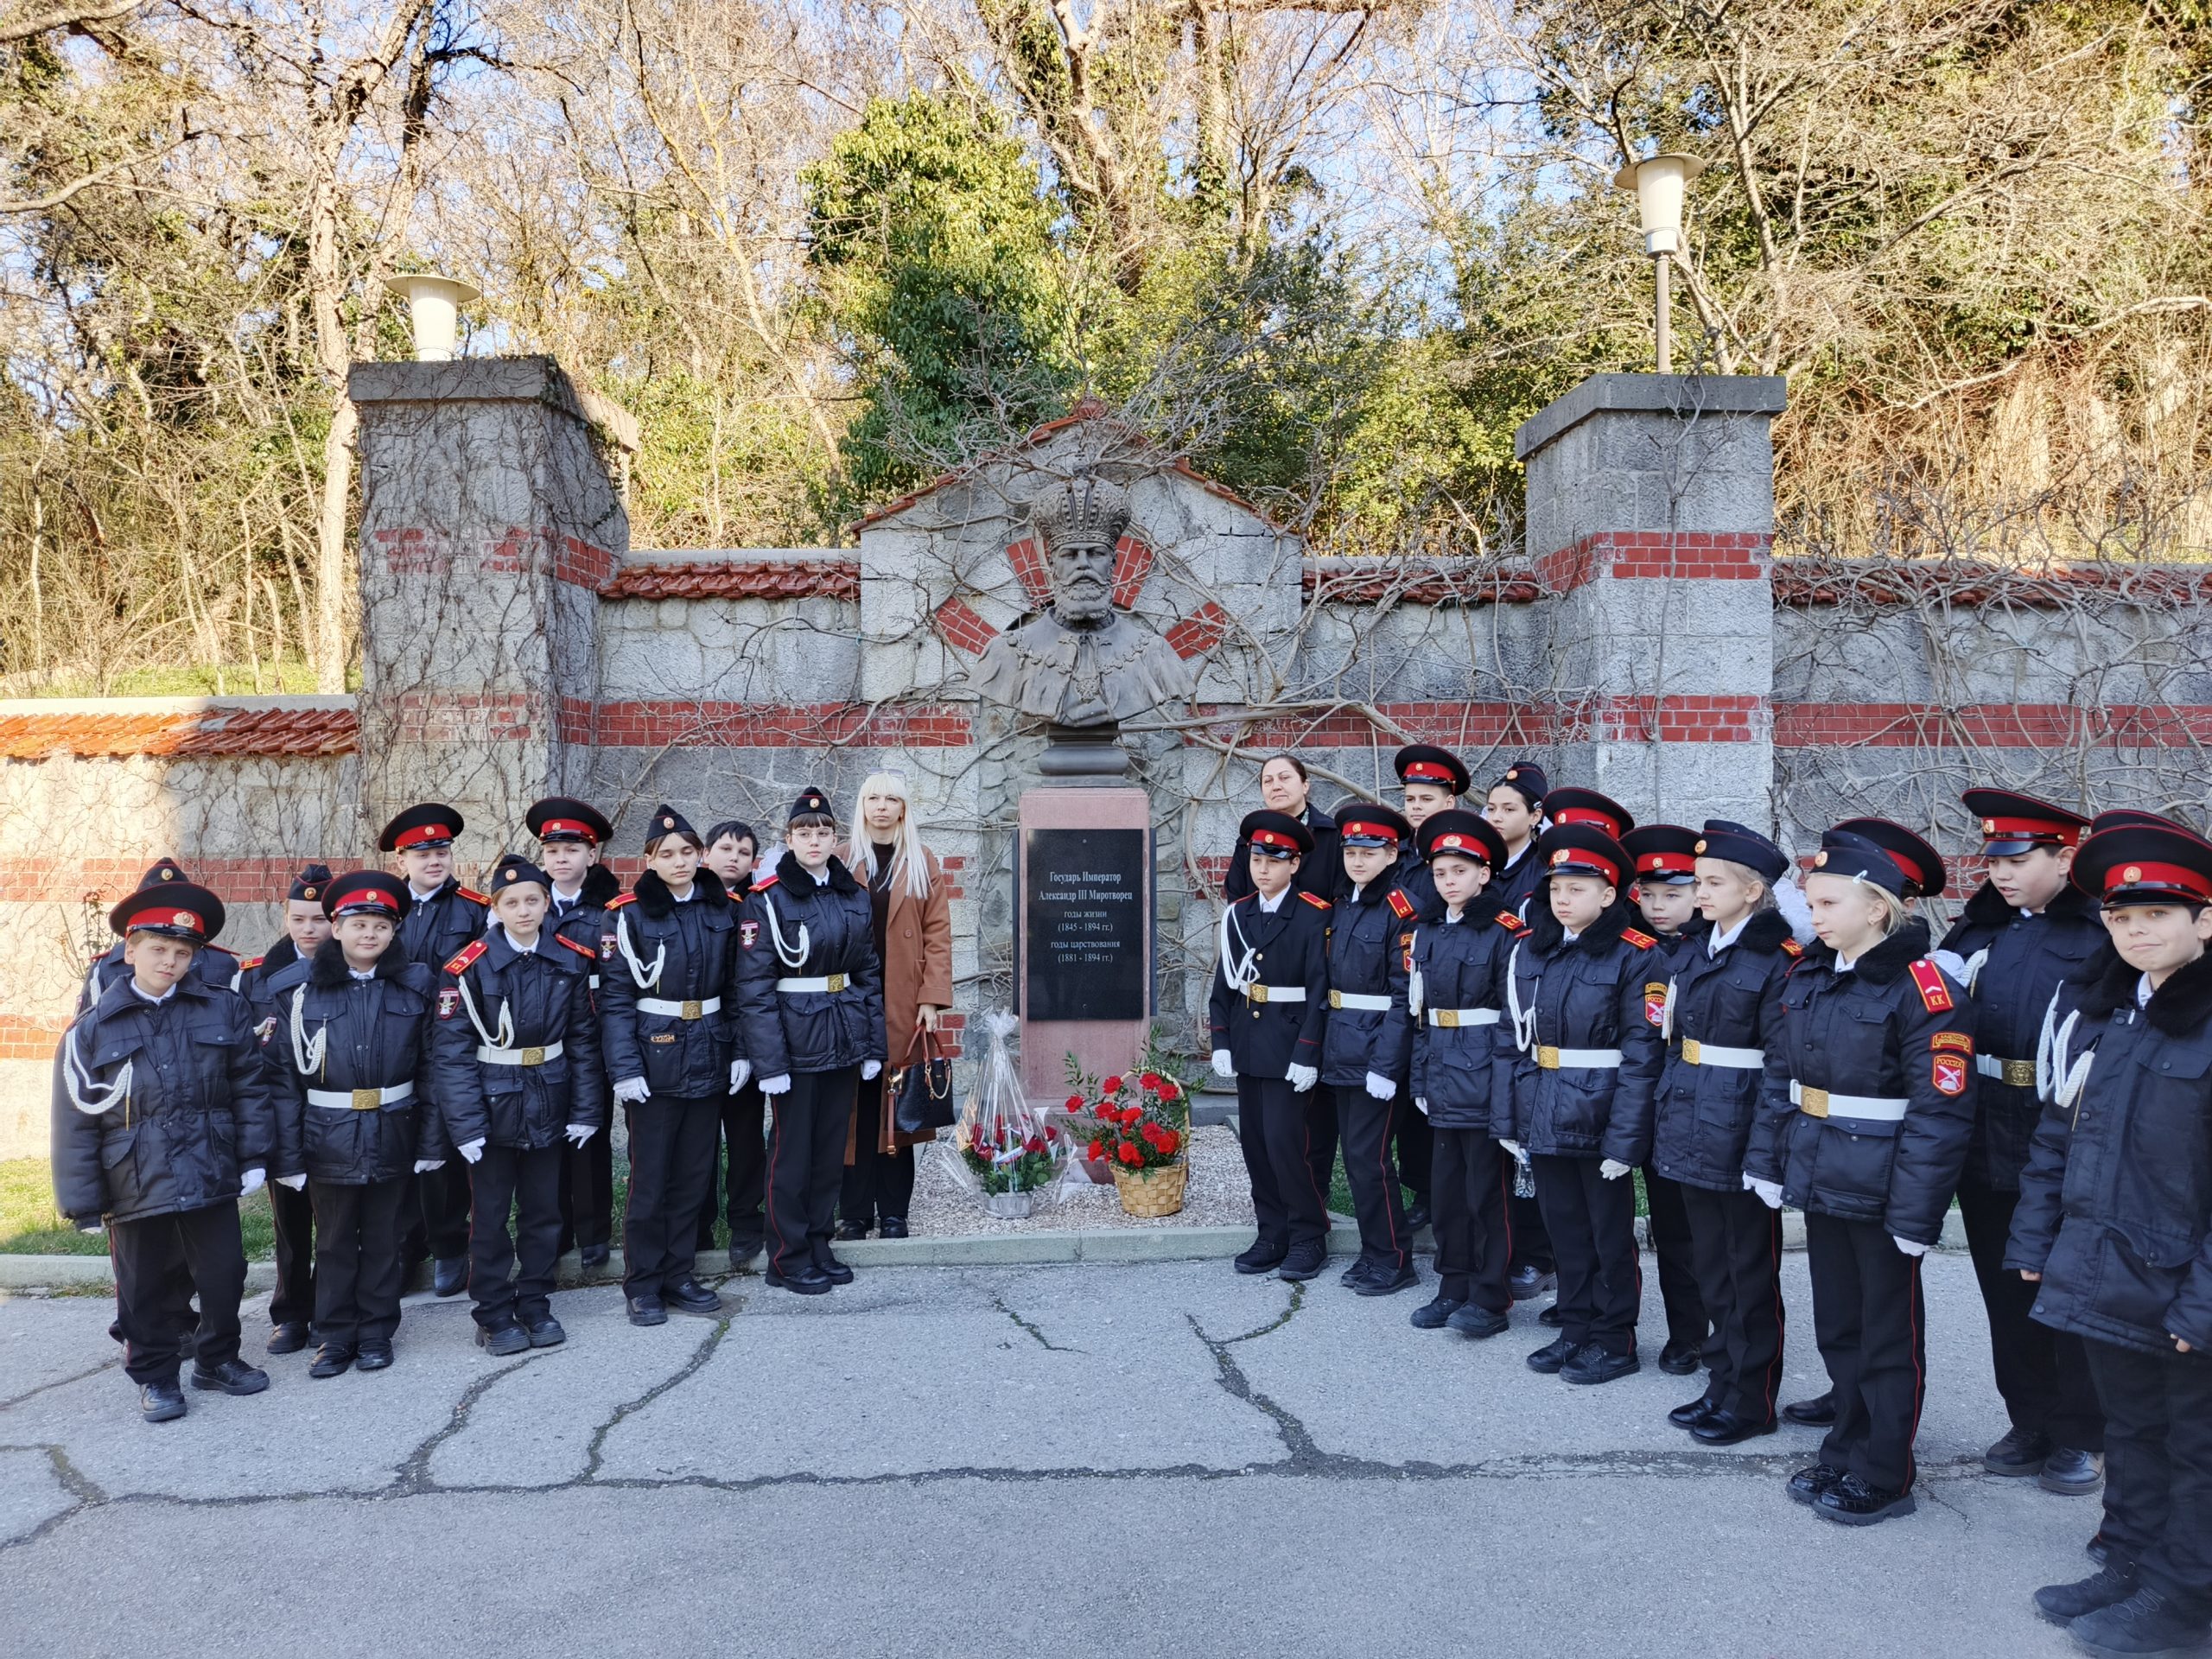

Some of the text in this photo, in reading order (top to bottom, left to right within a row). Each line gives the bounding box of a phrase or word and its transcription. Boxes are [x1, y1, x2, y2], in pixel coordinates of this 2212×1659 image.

[1050, 871, 1122, 884] Государь Император
[1039, 890, 1133, 902] Александр III Миротворец
[1058, 922, 1077, 932] (1845
[1084, 922, 1100, 931] 1894
[1071, 941, 1120, 950] царствования
[1058, 953, 1077, 963] (1881
[1084, 953, 1100, 962] 1894
